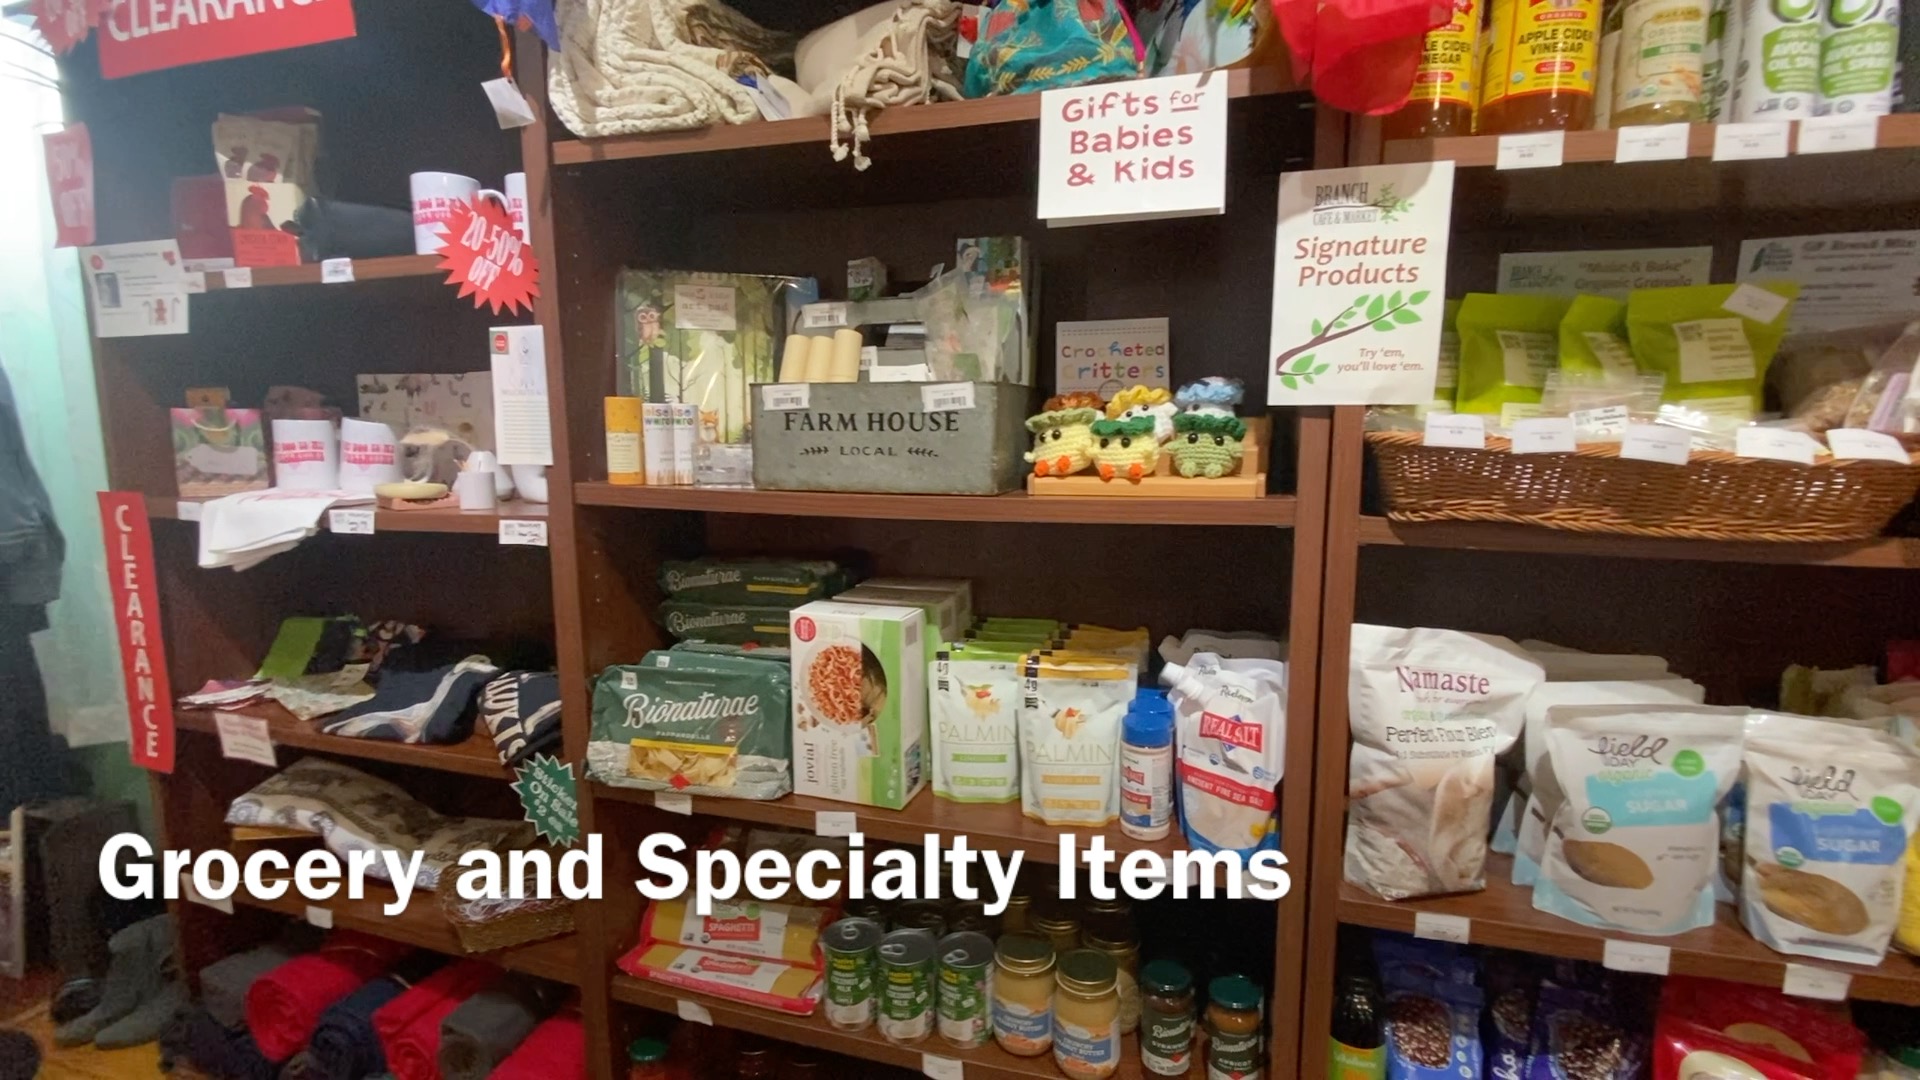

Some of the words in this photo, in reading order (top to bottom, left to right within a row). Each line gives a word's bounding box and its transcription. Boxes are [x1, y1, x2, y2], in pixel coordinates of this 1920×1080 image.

[1518, 28, 1559, 45] APPLE
[1562, 28, 1593, 42] CIDER
[1530, 41, 1584, 55] VINEGAR
[1062, 91, 1159, 122] Gifts
[1169, 91, 1206, 106] for
[1070, 124, 1193, 154] Babies
[1067, 163, 1095, 186] &
[1114, 155, 1194, 183] Kids
[1315, 182, 1369, 206] BRANCH
[460, 211, 524, 276] 20-50%
[1294, 236, 1427, 265] Signature
[468, 256, 501, 291] OFF
[1299, 262, 1420, 287] Products
[1062, 341, 1165, 358] Crocheted
[1360, 348, 1377, 360] Try
[1062, 362, 1165, 379] Critters
[1337, 361, 1371, 374] you'll
[1373, 361, 1396, 372] love
[784, 412, 858, 432] FARM
[868, 411, 960, 432] HOUSE
[840, 446, 898, 457] LOCAL
[115, 504, 159, 758] CLEARANCE
[1396, 666, 1490, 695] Namaste
[803, 742, 819, 785] jovial
[529, 781, 549, 803] On
[1232, 791, 1246, 801] SEA
[1626, 799, 1689, 814] SUGAR
[1816, 838, 1881, 853] SUGAR
